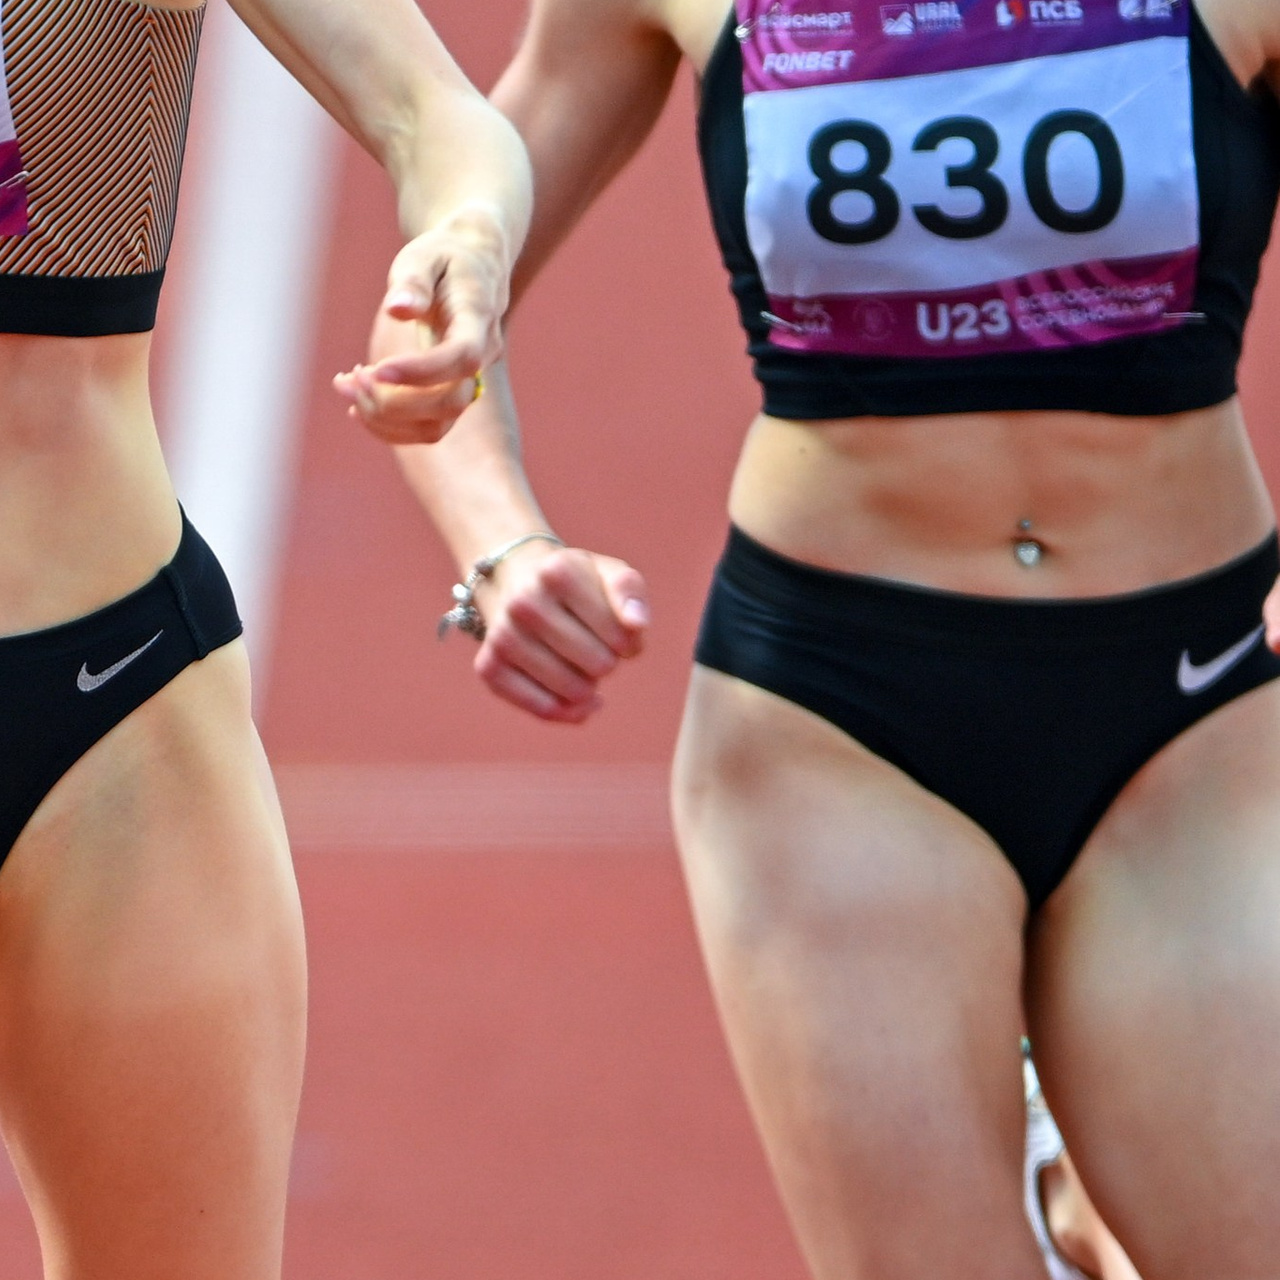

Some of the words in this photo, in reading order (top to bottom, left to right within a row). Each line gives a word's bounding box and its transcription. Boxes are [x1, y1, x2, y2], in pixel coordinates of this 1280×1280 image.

[1029, 0, 1083, 20] ПСБ
[762, 50, 855, 72] FONBET
[806, 108, 1124, 246] 830
[916, 298, 1011, 341] U23
